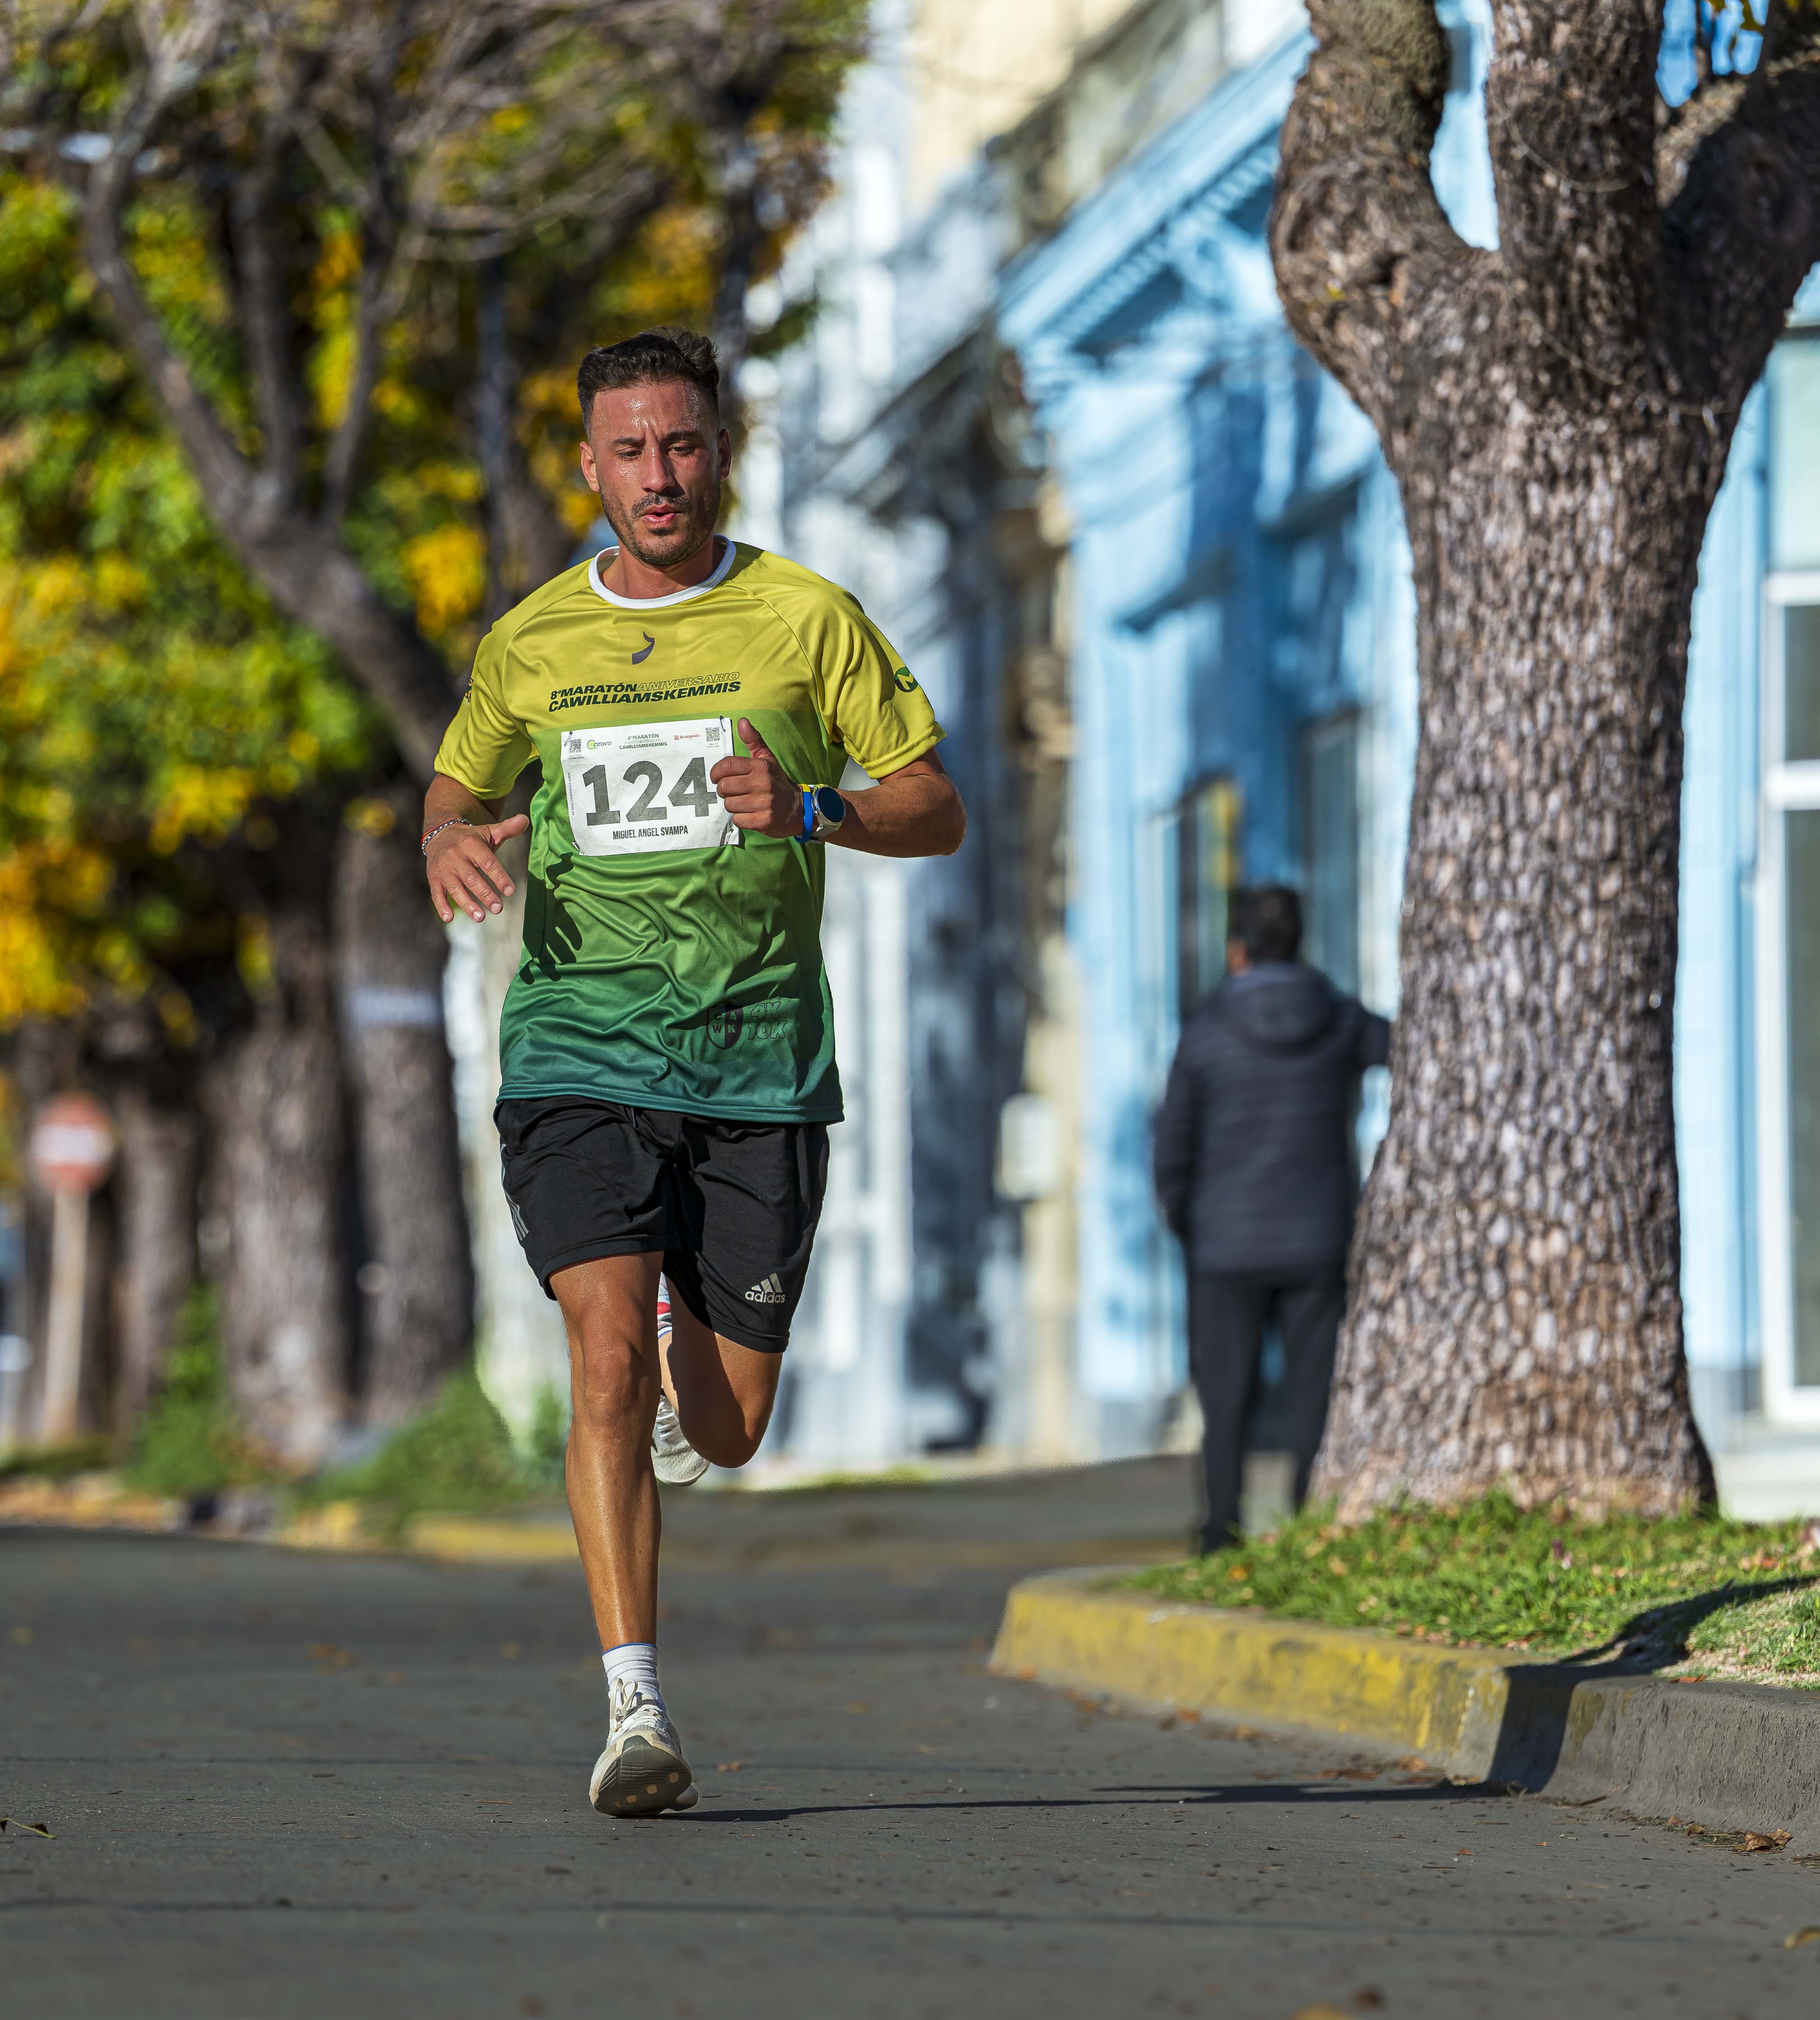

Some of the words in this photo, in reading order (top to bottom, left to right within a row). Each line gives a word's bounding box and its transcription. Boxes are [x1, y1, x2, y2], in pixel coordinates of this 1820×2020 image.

[548, 681, 741, 712] CAWILLIAMSKEMMIS
[582, 757, 718, 826] 124
[613, 829, 637, 840] MIGUEL
[638, 828, 659, 838] ANGEL
[660, 825, 688, 836] SVAMPA
[751, 1001, 781, 1019] 4K
[748, 1020, 788, 1040] 10K
[745, 1291, 785, 1303] adidas
